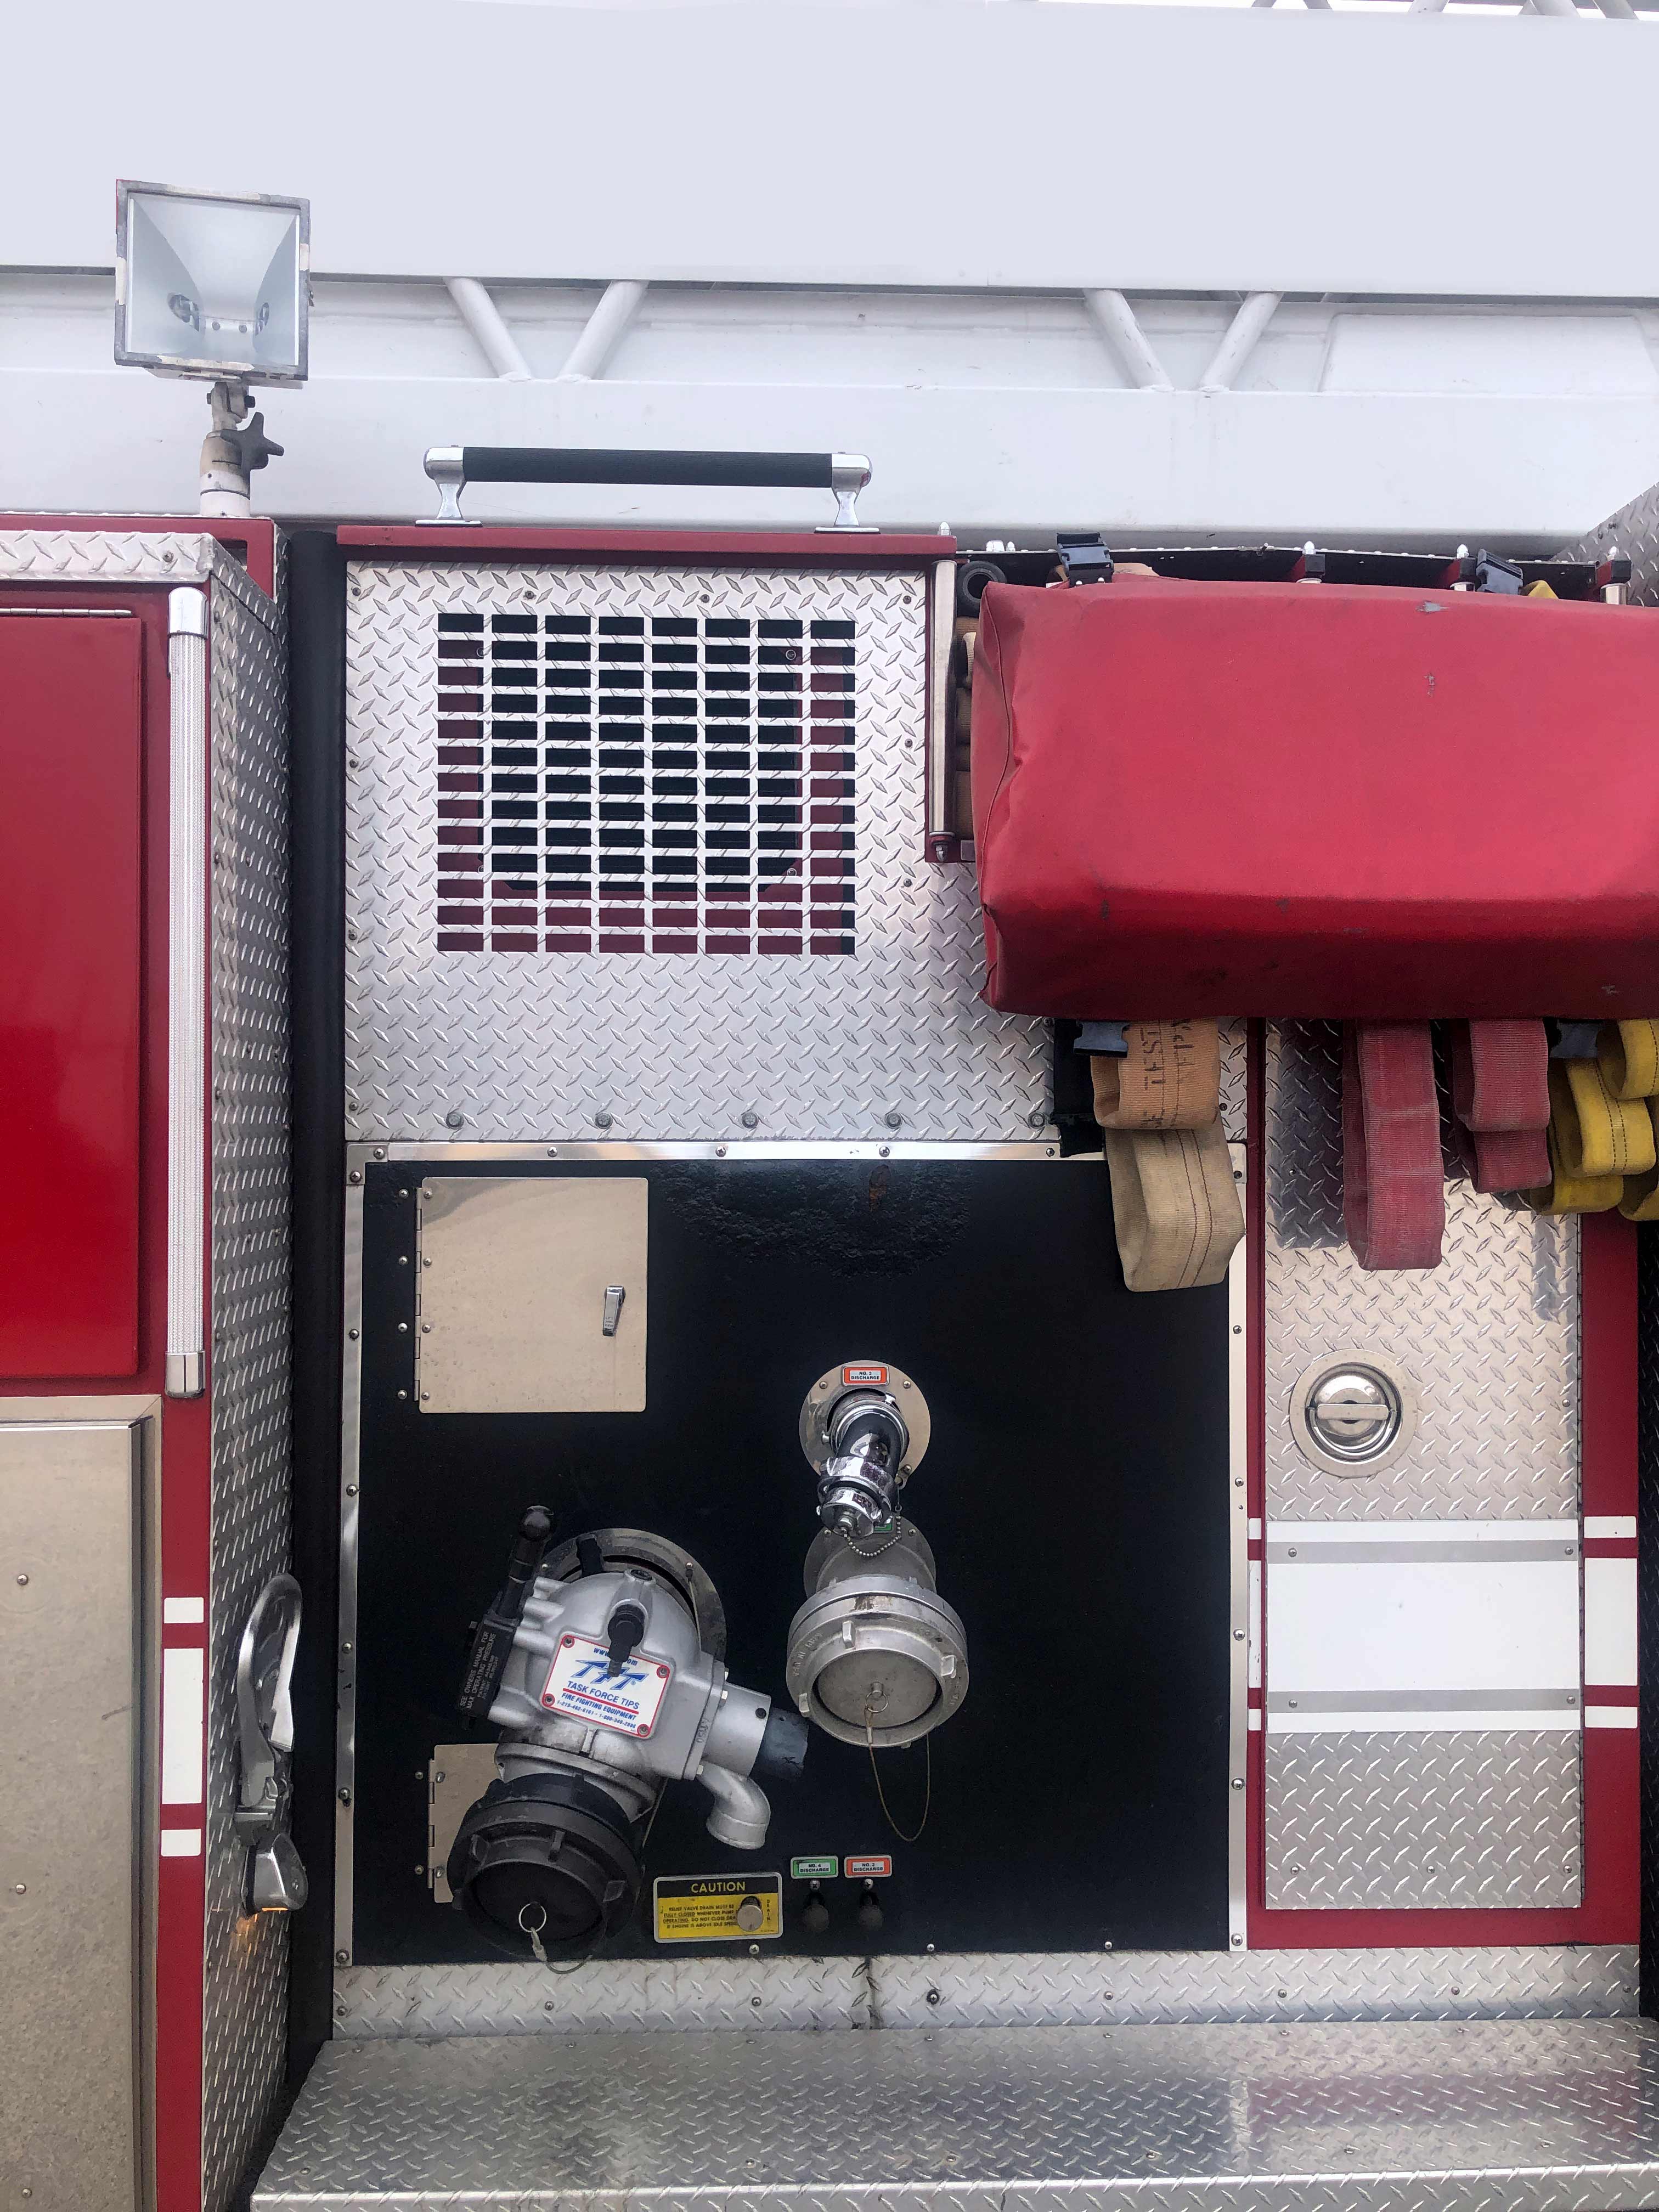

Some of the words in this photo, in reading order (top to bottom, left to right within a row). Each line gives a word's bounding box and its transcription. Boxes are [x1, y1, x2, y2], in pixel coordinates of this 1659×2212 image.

[460, 1696, 468, 1707] SEE
[473, 1646, 485, 1668] MANUAL
[481, 1632, 489, 1643] FOR
[466, 1697, 476, 1709] MAX
[471, 1663, 486, 1694] OPERATING
[482, 1633, 496, 1661] PRESSURE
[561, 1692, 575, 1703] FIRE
[575, 1696, 602, 1710] FIGHTING
[603, 1706, 636, 1720] EQUIPMENT
[567, 1680, 587, 1692] TASK
[589, 1688, 619, 1703] FORCE
[622, 1697, 640, 1709] TIPS
[691, 1881, 746, 1893] CAUTION
